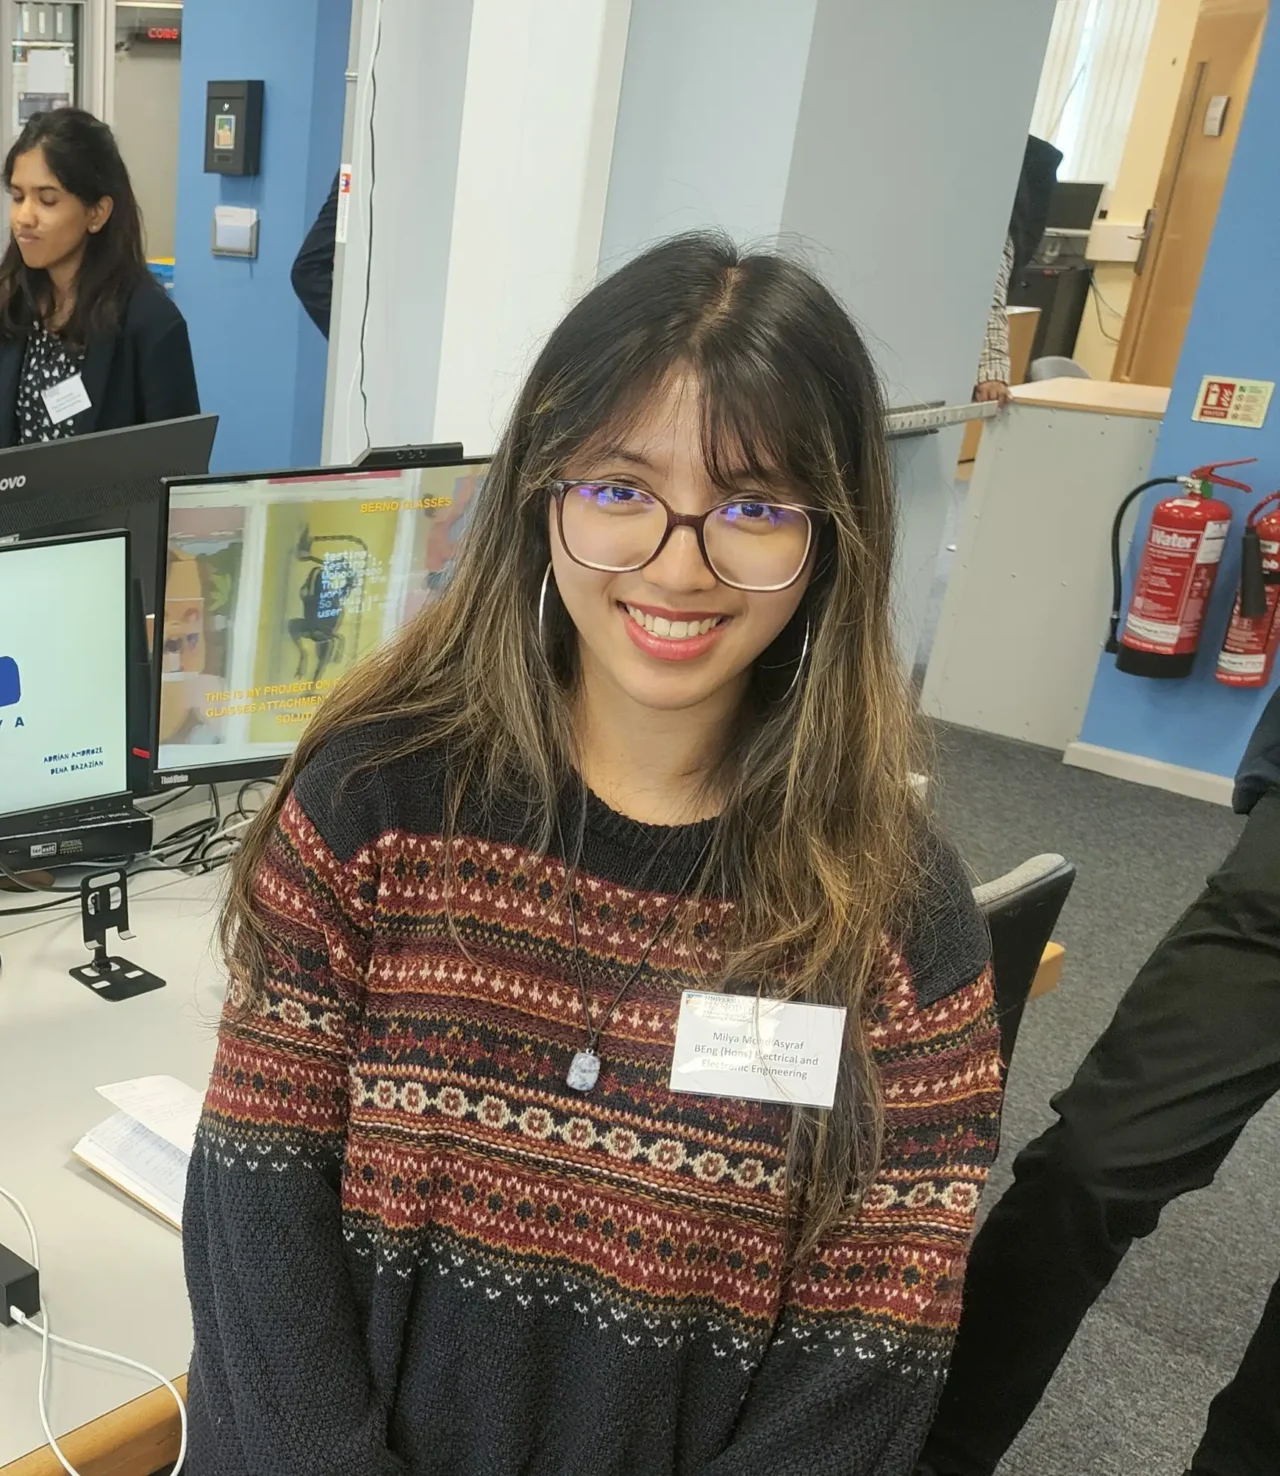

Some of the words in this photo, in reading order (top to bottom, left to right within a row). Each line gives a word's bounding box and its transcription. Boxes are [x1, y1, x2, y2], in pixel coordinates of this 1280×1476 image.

[360, 501, 398, 514] BERNO
[400, 497, 452, 509] GLASSES
[317, 608, 342, 618] user
[205, 691, 229, 703] THIS
[264, 681, 313, 695] PROJECT
[206, 703, 257, 717] GLASSES
[275, 711, 311, 725] SOLUT
[713, 1032, 740, 1044] Milya
[773, 1039, 804, 1051] Asyraf
[694, 1044, 718, 1057] BEng
[720, 1048, 752, 1060] (Hons)
[800, 1057, 819, 1067] and
[751, 1066, 808, 1081] Engineering
